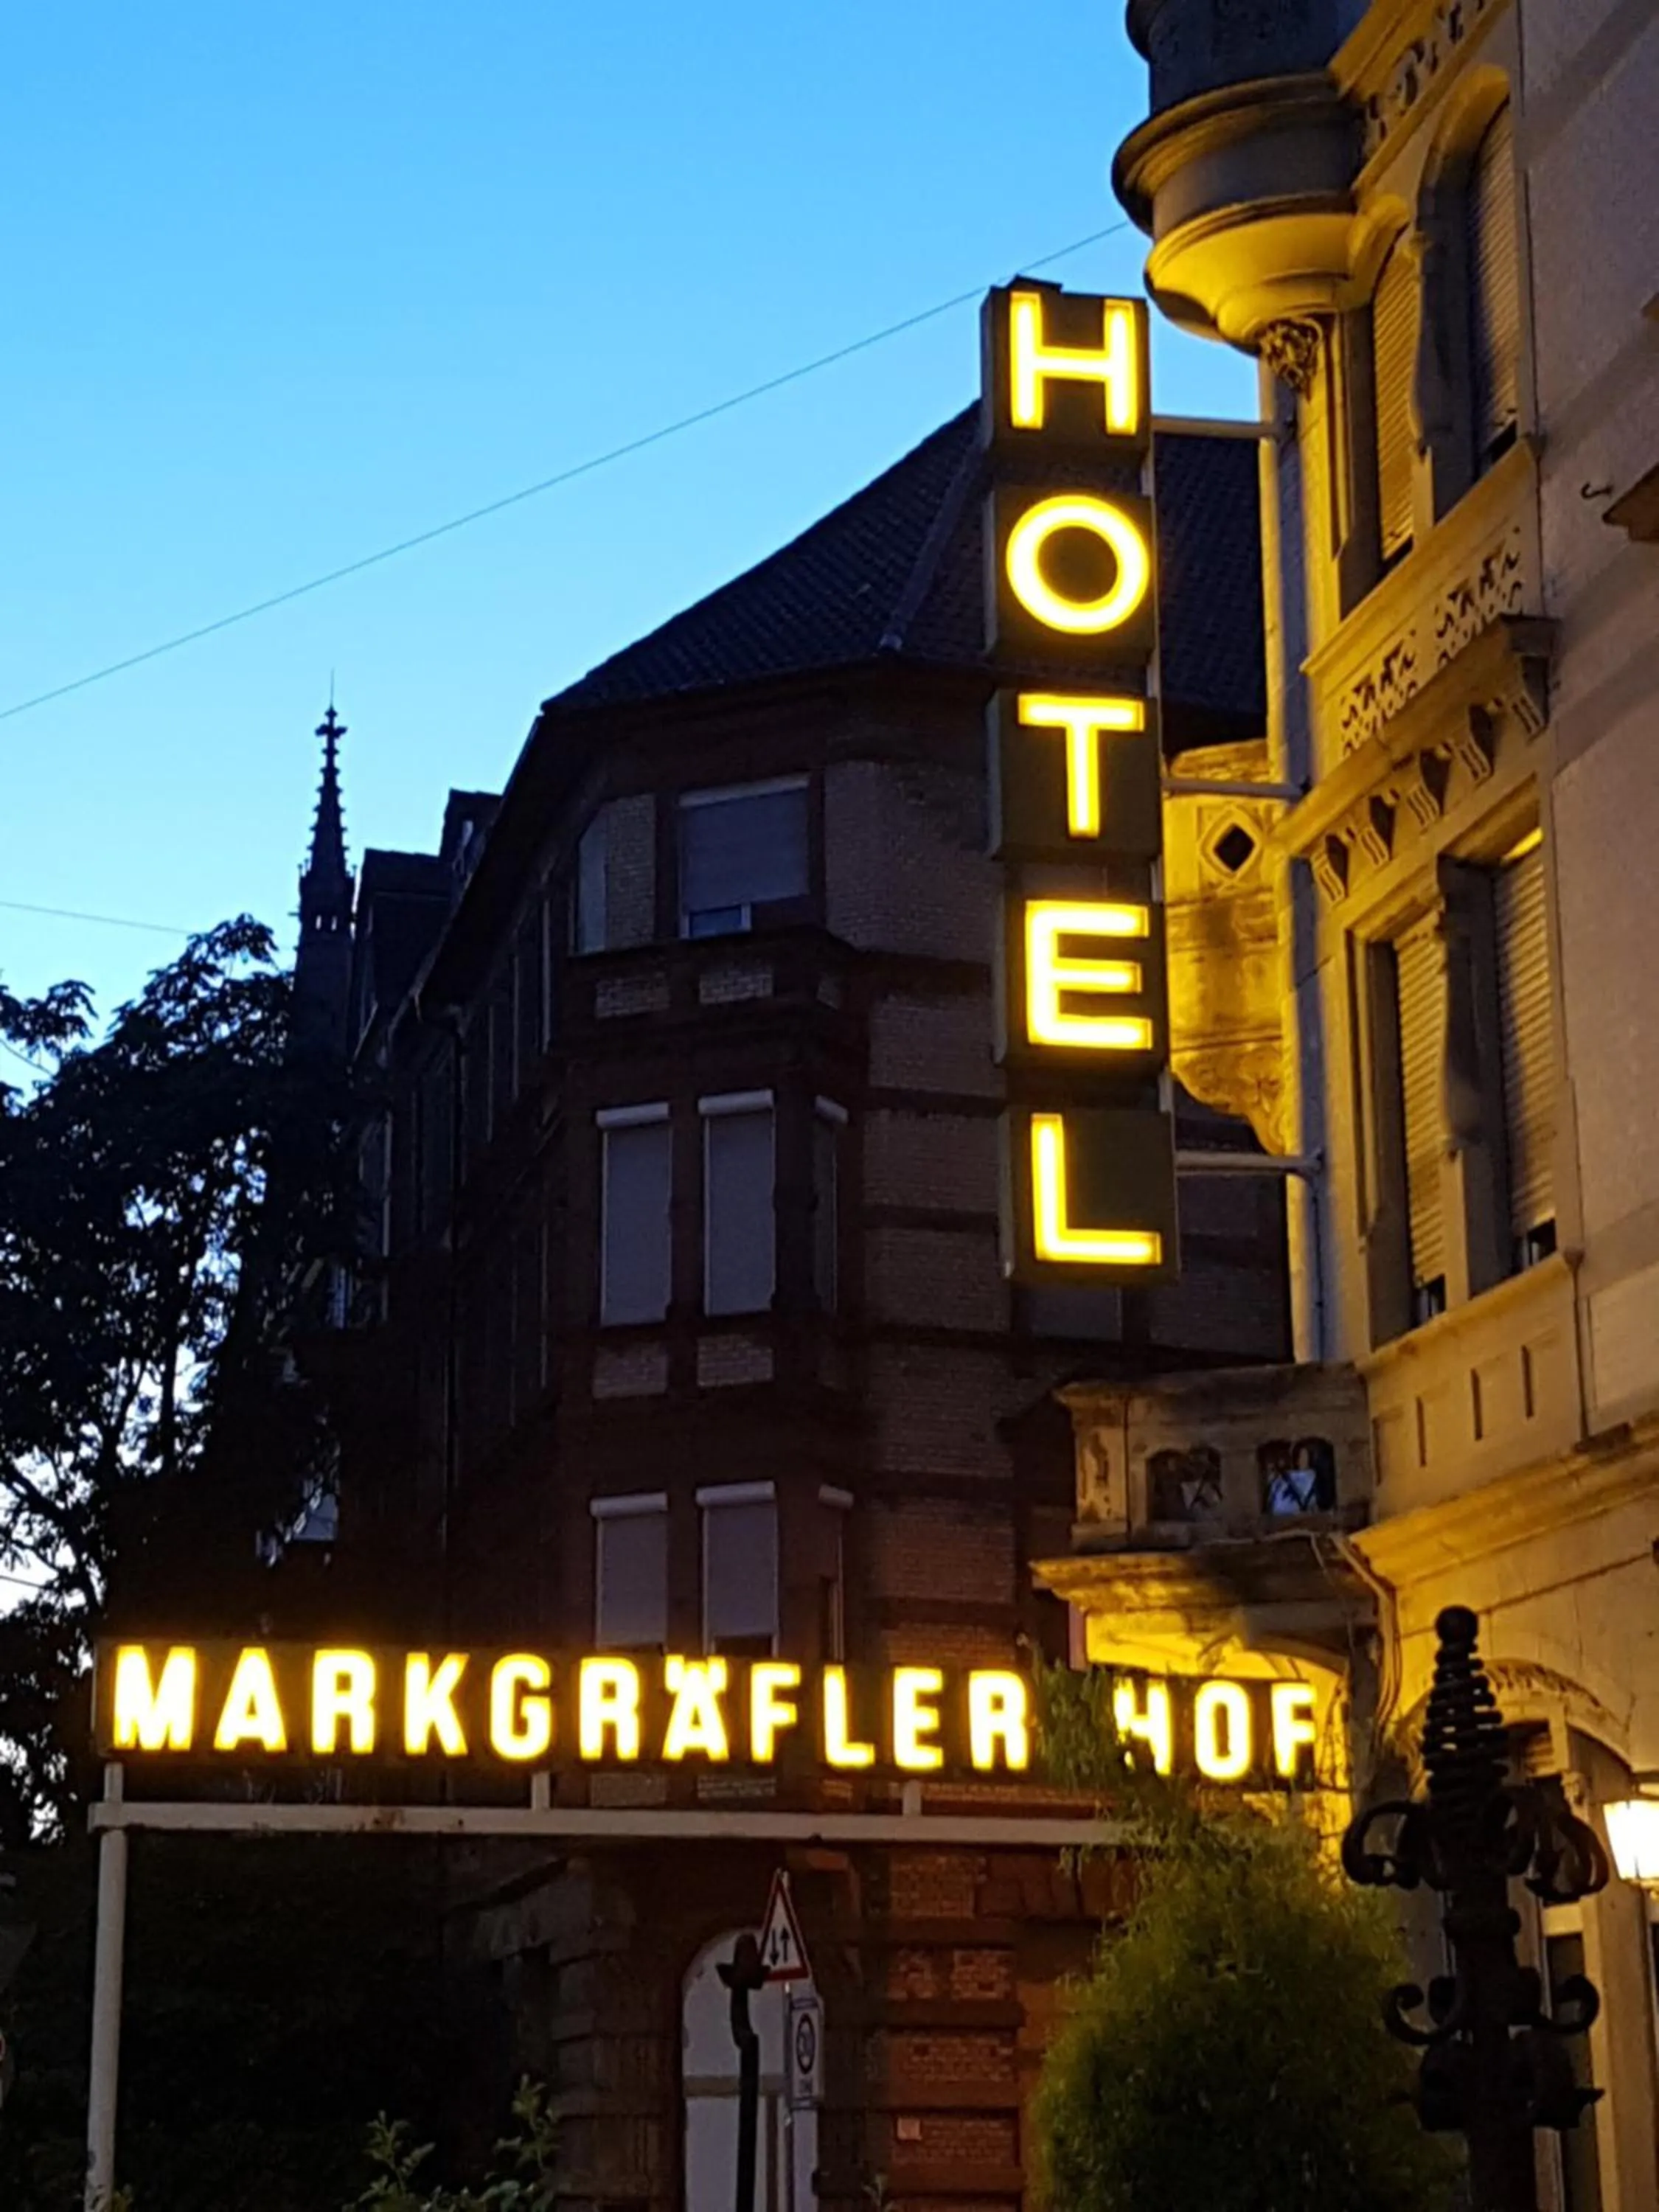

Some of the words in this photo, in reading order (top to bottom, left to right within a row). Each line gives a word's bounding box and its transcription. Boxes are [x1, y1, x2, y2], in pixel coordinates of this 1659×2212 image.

[1005, 290, 1164, 1266] HOTEL
[112, 1644, 1029, 1771] MARKGRÄFLER
[1113, 1676, 1318, 1780] HOF
